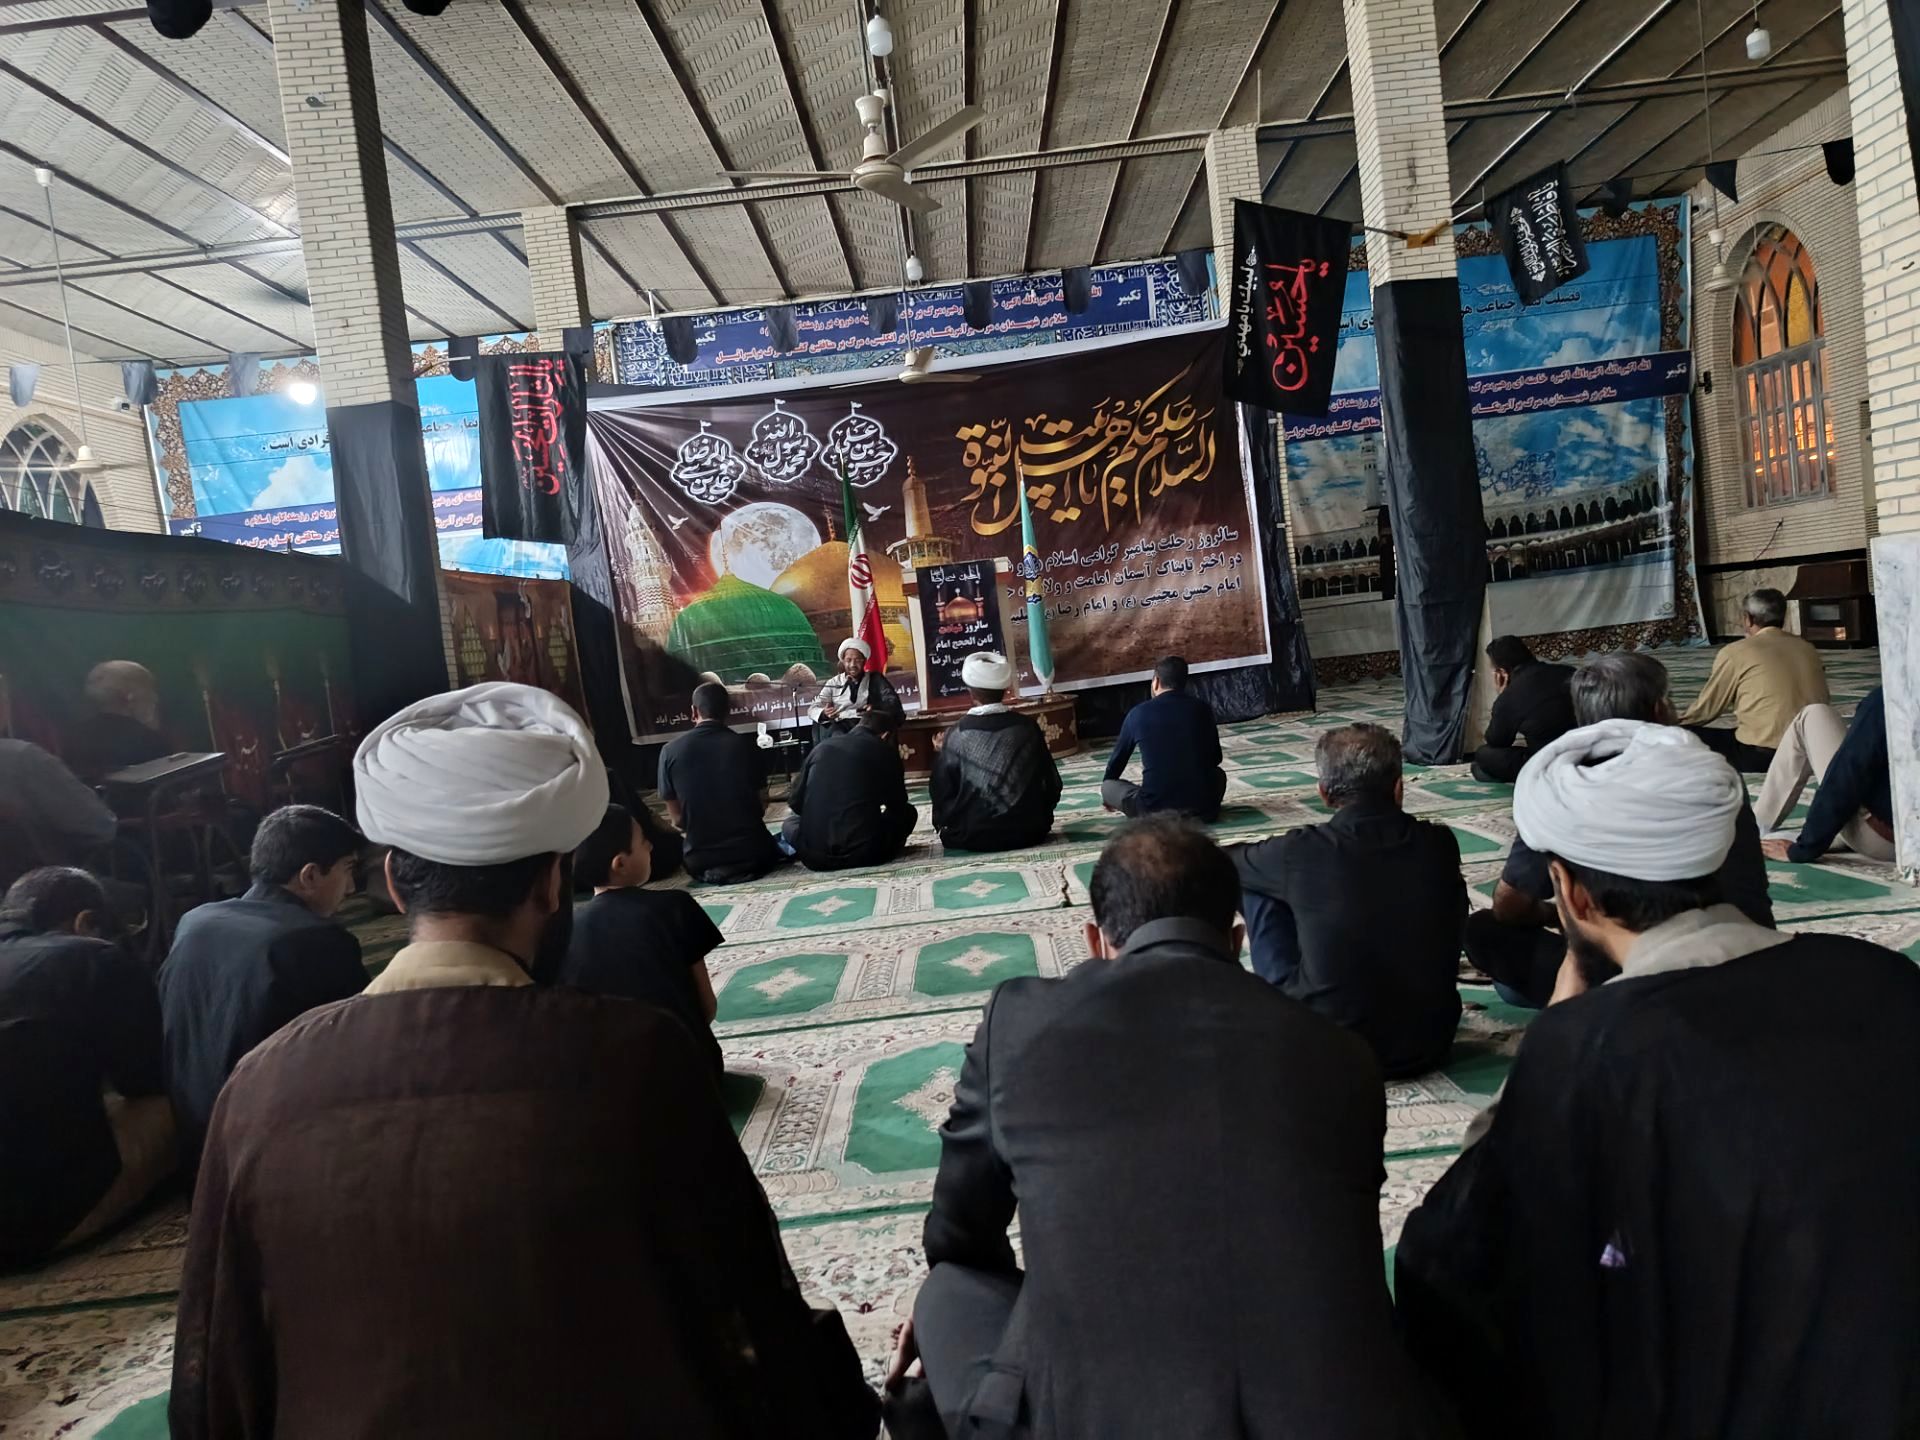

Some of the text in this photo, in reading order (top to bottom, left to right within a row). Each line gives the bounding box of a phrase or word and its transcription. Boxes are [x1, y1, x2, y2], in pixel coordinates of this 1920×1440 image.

[1117, 289, 1141, 306] تکبیر
[1665, 363, 1687, 379] تکبیر
[1197, 526, 1239, 550] سالروز
[1080, 543, 1119, 567] گرامی
[1122, 539, 1156, 561] پیامبر
[1045, 549, 1079, 572] اسلام
[1156, 557, 1193, 576] تابناک
[1198, 551, 1224, 575] اختر
[1228, 553, 1242, 570] دو
[1073, 569, 1111, 589] امامت
[1112, 561, 1151, 586] آسمان
[1064, 581, 1073, 594] و
[1182, 583, 1212, 602] حسن
[1216, 576, 1241, 597] امام
[1082, 594, 1108, 617] امام
[1111, 598, 1119, 612] و
[1140, 588, 1178, 607] مجتبی
[1056, 602, 1080, 618] رضا
[965, 620, 989, 634] سالروز
[935, 640, 951, 652] امام
[977, 634, 994, 647] ثامن
[752, 702, 768, 717] امام
[771, 700, 786, 713] دفتر
